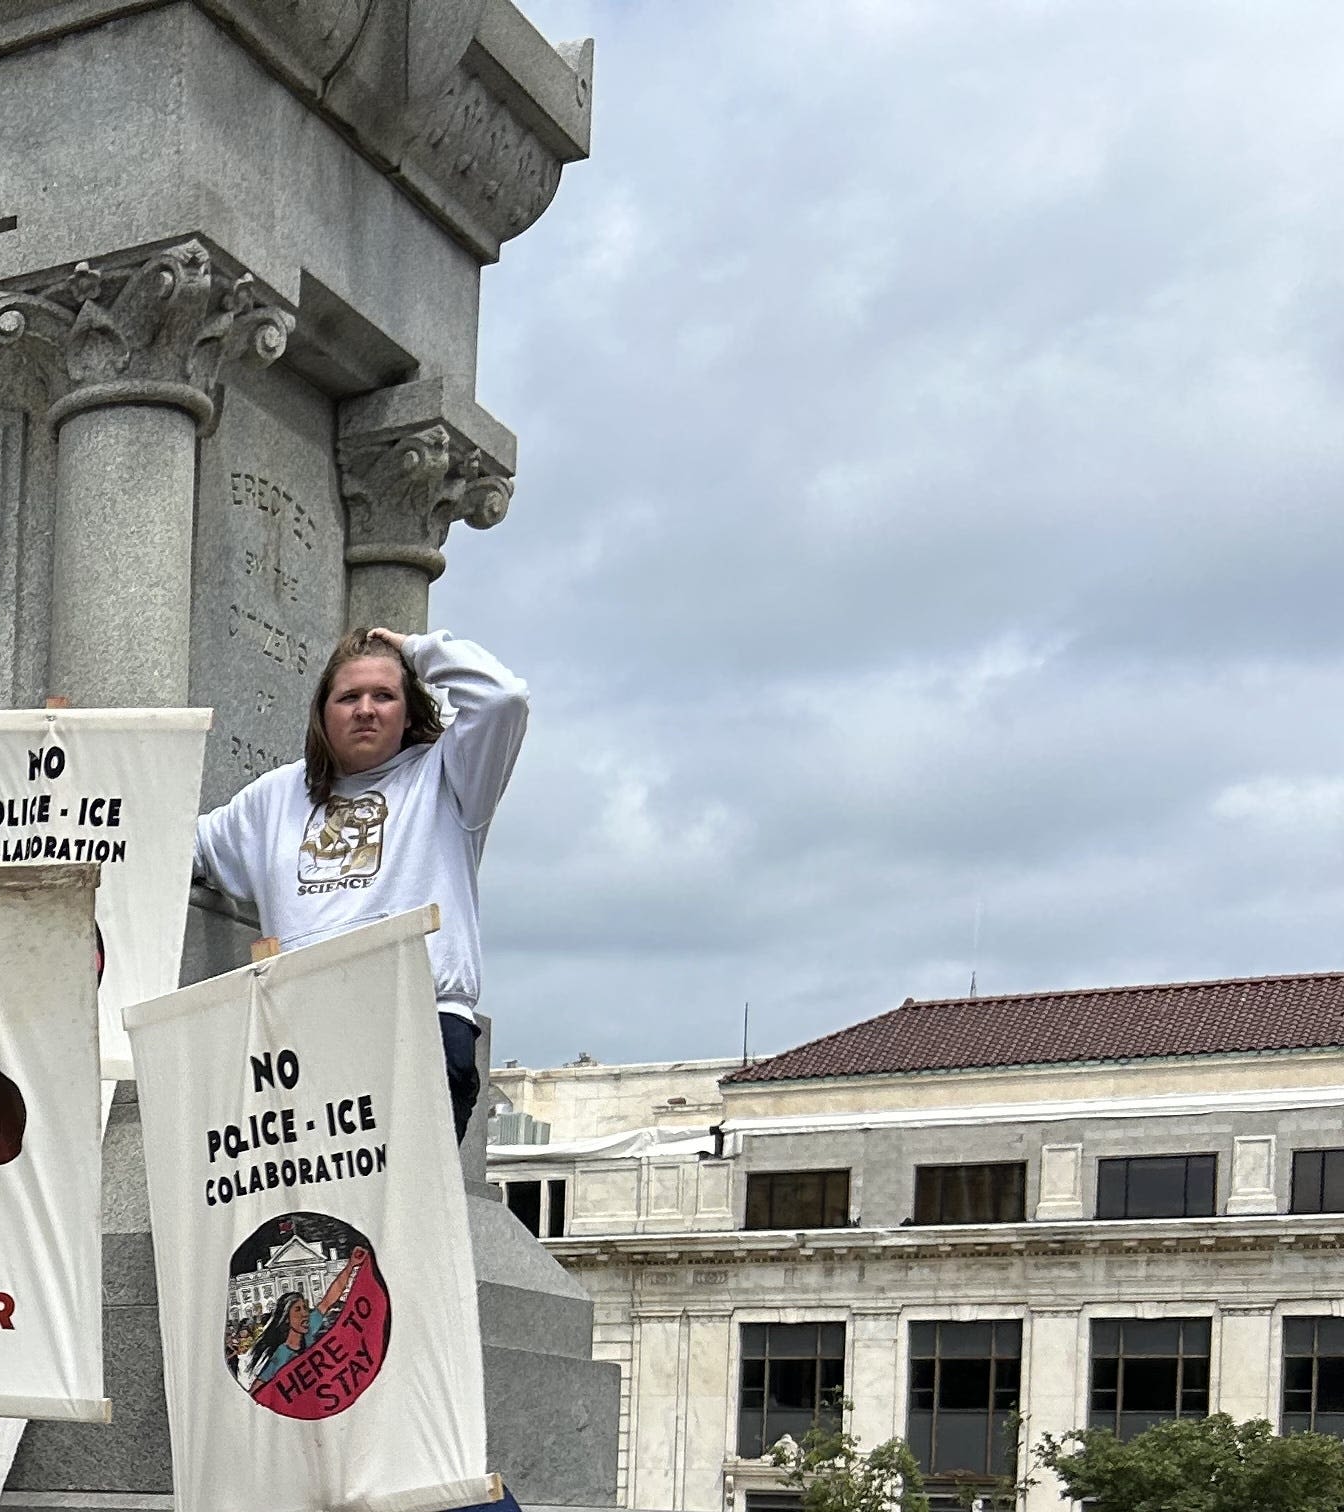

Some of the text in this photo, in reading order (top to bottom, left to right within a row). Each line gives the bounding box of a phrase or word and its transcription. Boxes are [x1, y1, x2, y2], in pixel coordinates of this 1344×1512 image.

[28, 746, 65, 781] NO
[78, 798, 122, 827] ICE
[250, 1049, 299, 1092] NO
[325, 1094, 376, 1136] ICE
[276, 1296, 372, 1404] HERE TO
[316, 1337, 374, 1411] STAY
